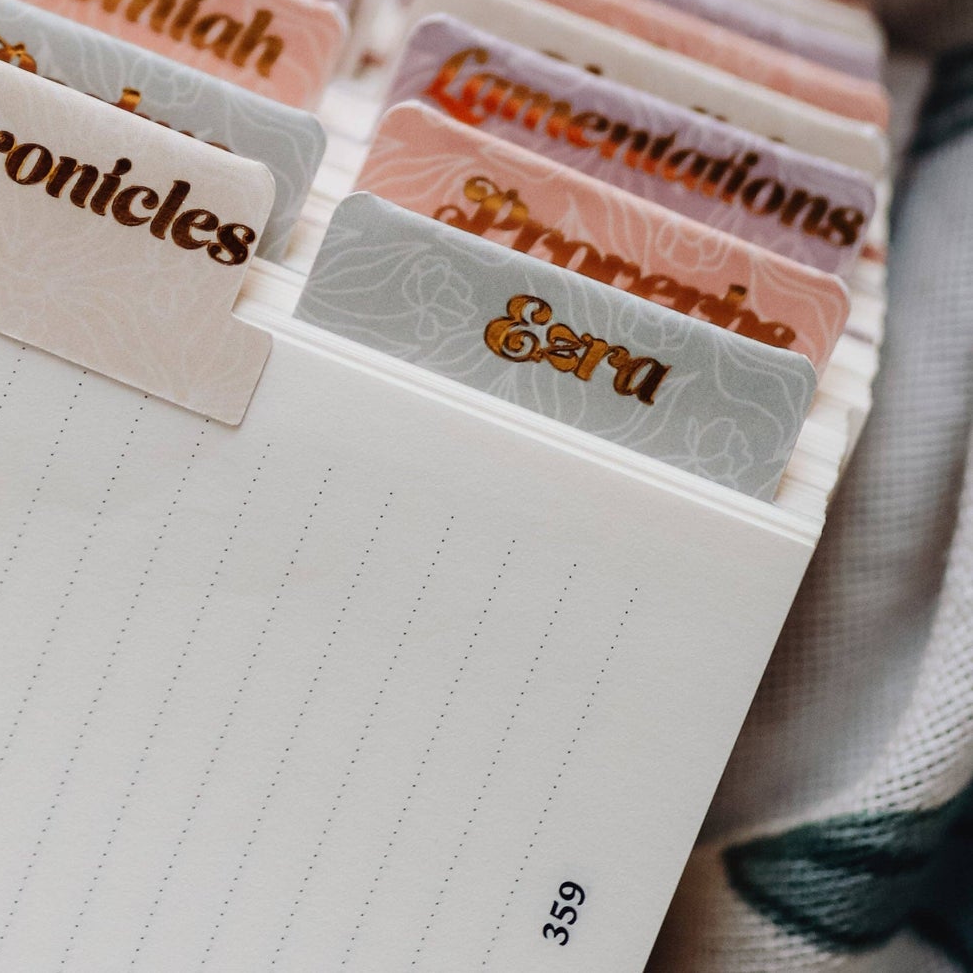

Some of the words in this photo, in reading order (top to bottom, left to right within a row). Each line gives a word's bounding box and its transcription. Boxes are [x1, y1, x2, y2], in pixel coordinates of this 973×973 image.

[425, 47, 866, 247] Lamentations
[483, 294, 672, 406] Ezra
[542, 881, 586, 946] 359
